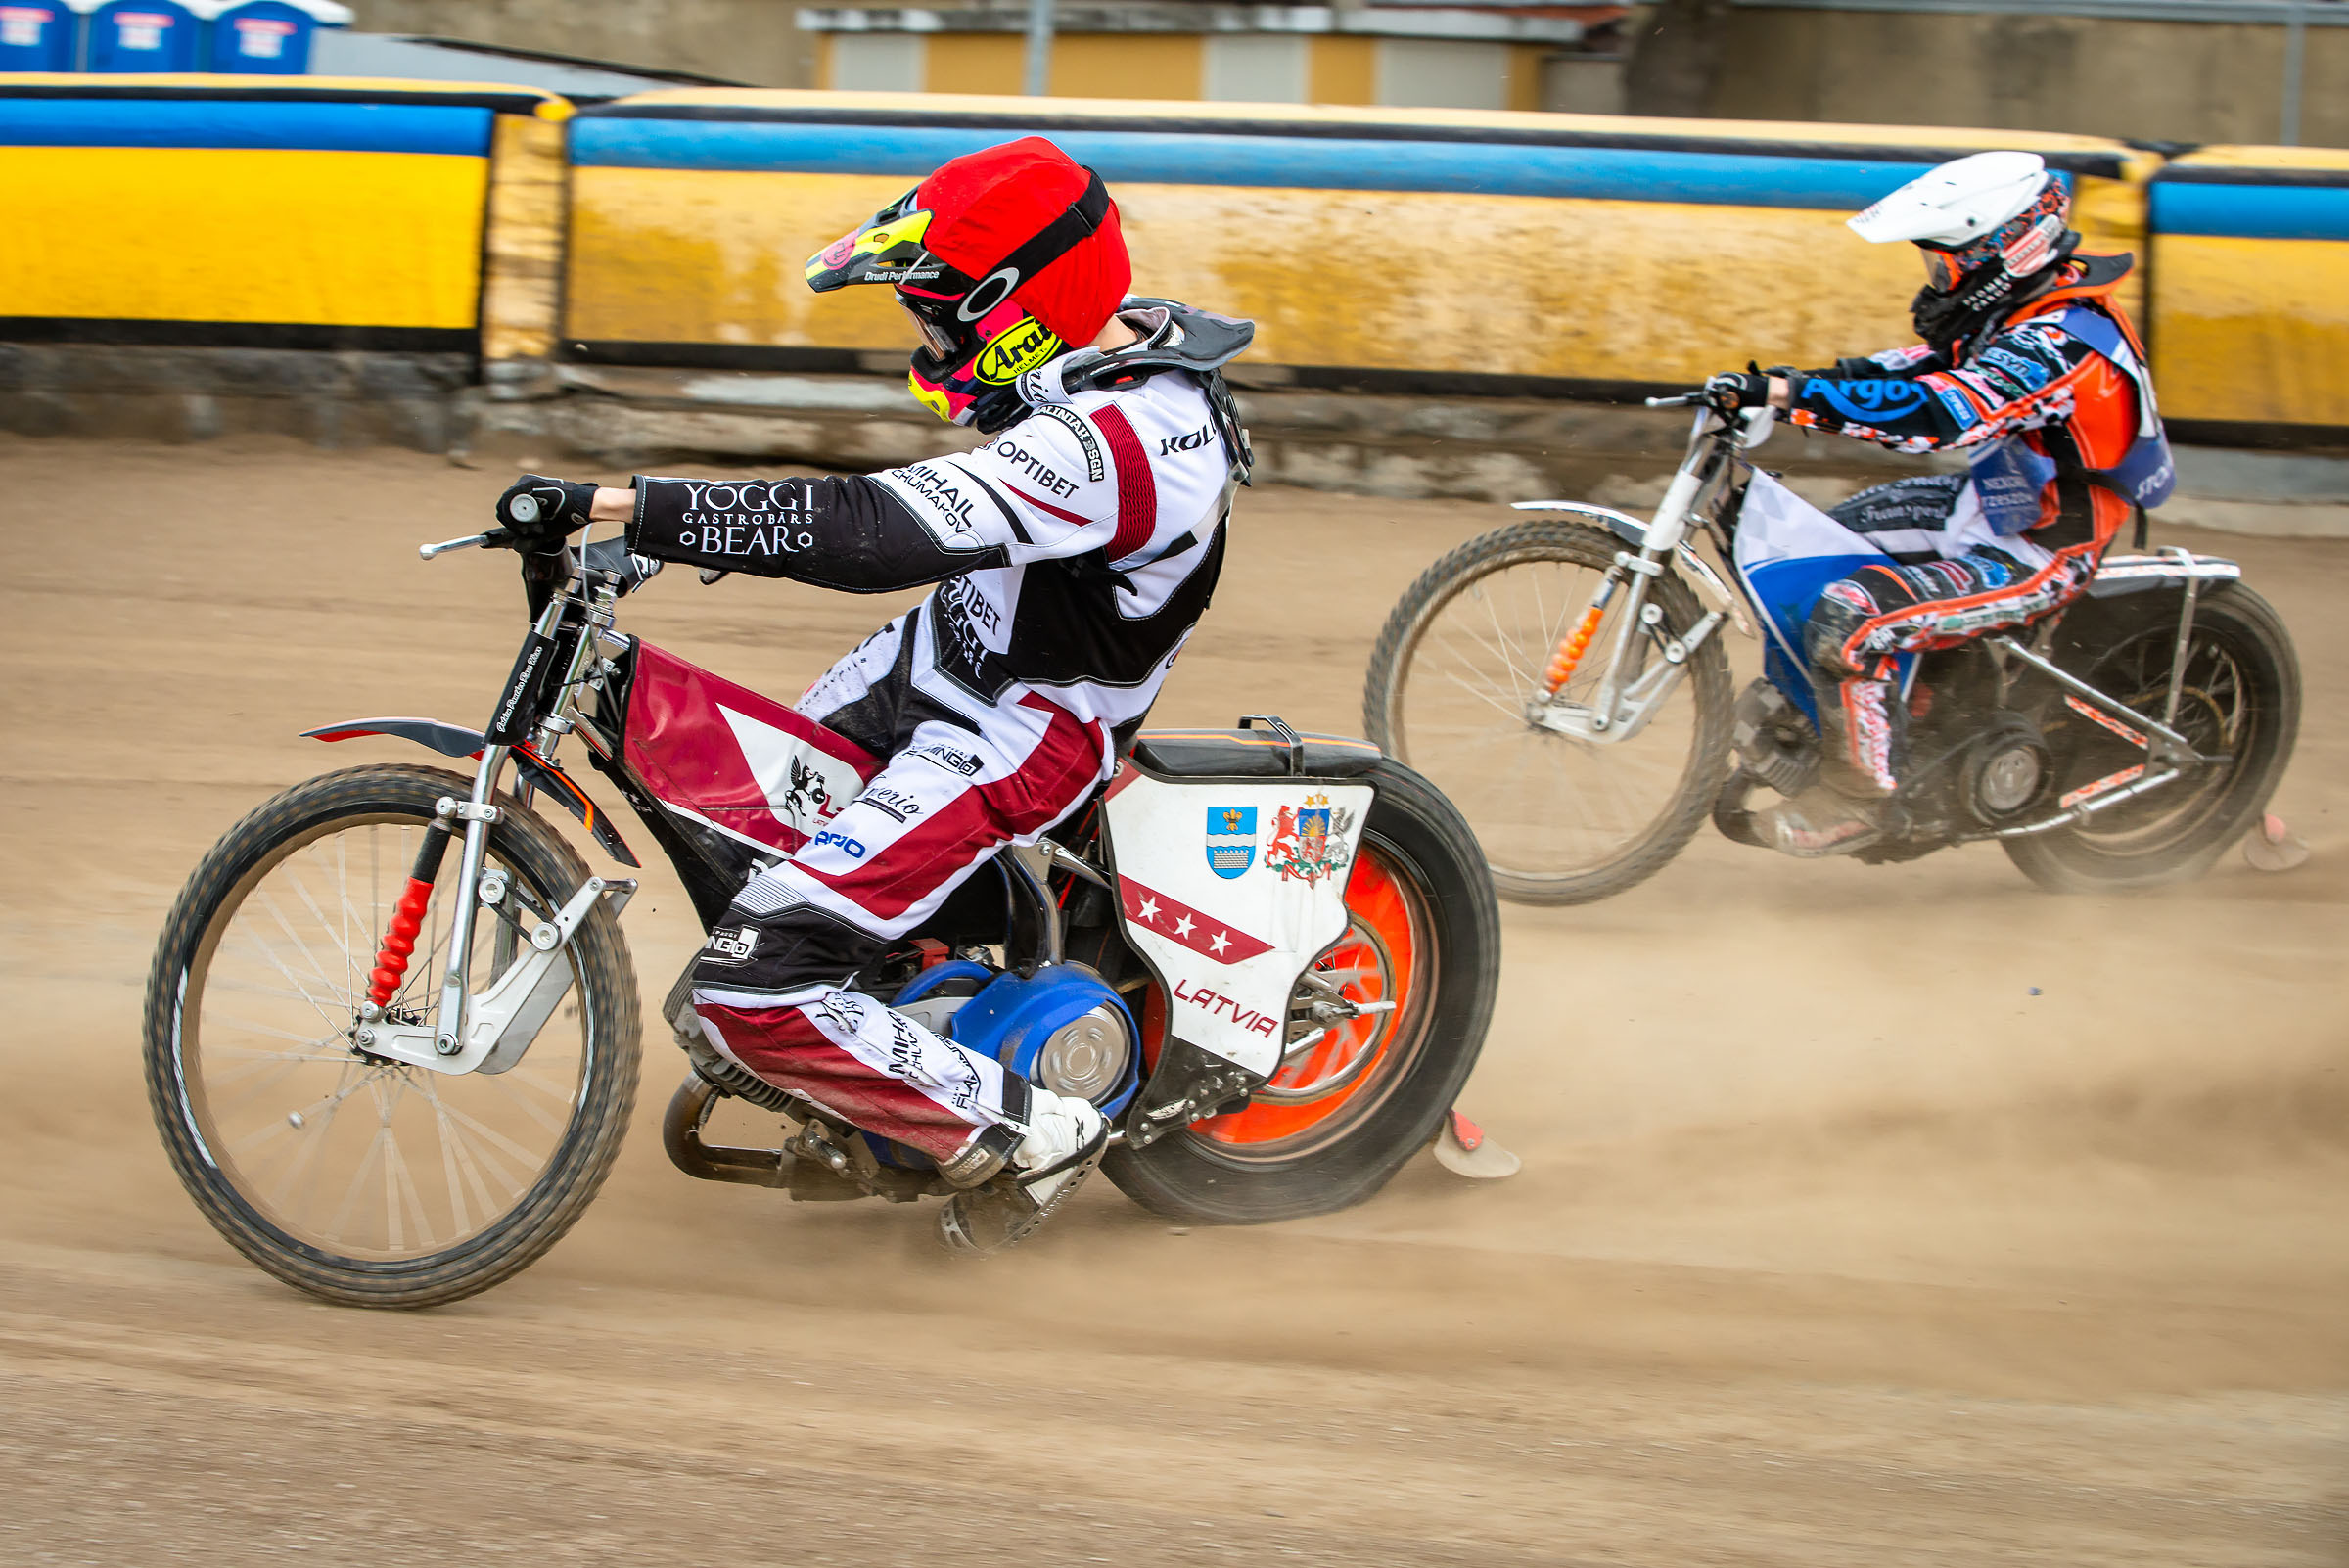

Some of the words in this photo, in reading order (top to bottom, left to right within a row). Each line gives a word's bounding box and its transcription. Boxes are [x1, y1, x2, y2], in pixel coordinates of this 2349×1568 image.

[864, 271, 888, 282] Drudi
[888, 270, 940, 281] Perfrmance
[1013, 348, 1045, 374] HELMET
[997, 441, 1080, 499] OPTIBET
[681, 482, 814, 512] YOGGI
[891, 469, 967, 533] CHUMAKOV
[700, 525, 800, 556] BEAR
[1174, 979, 1279, 1038] LATVIA
